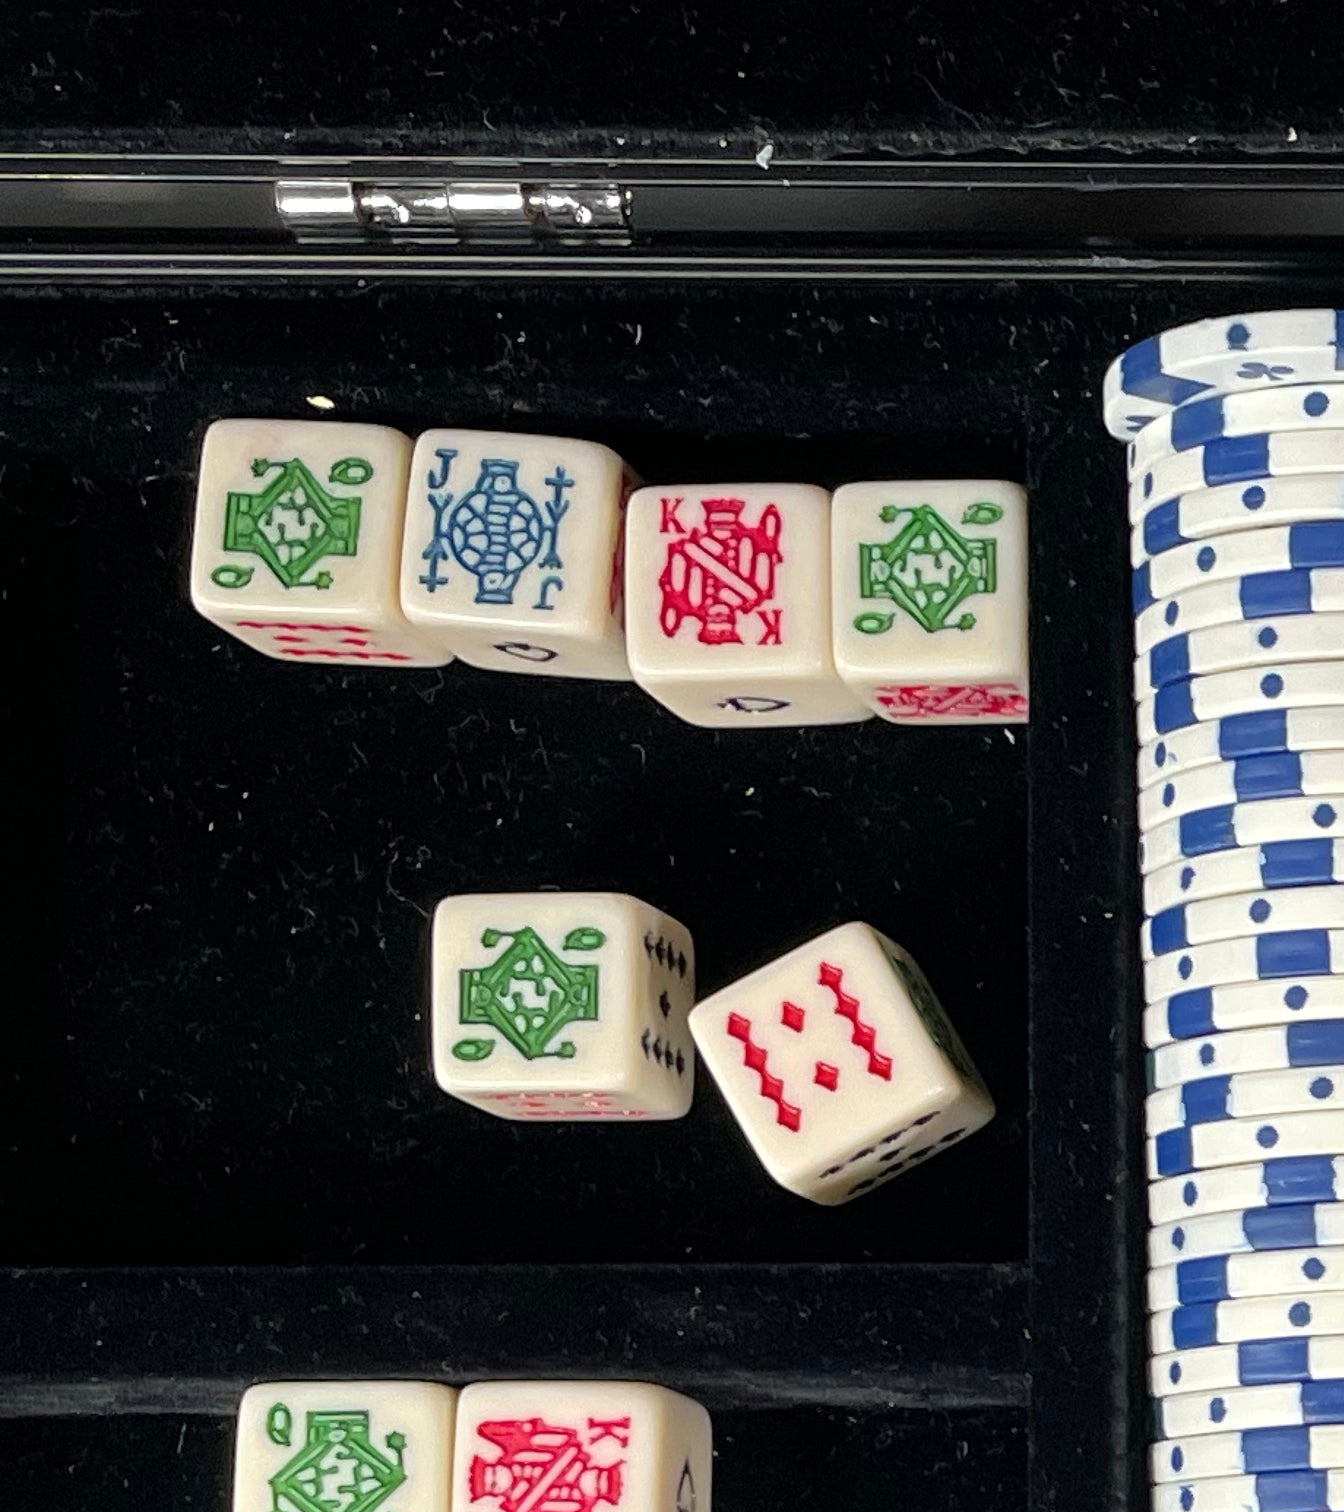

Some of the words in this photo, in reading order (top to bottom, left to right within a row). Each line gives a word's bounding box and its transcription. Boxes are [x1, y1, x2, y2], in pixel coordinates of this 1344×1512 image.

[329, 457, 373, 485] Q
[428, 449, 458, 489] J
[659, 498, 686, 533] K
[961, 502, 1003, 525] Q
[210, 565, 254, 588] Q
[533, 576, 563, 610] J
[757, 610, 782, 645] K
[853, 611, 896, 634] Q
[563, 927, 606, 951] Q
[452, 1038, 496, 1061] Q
[266, 1402, 293, 1447] Q
[588, 1417, 631, 1448] K
